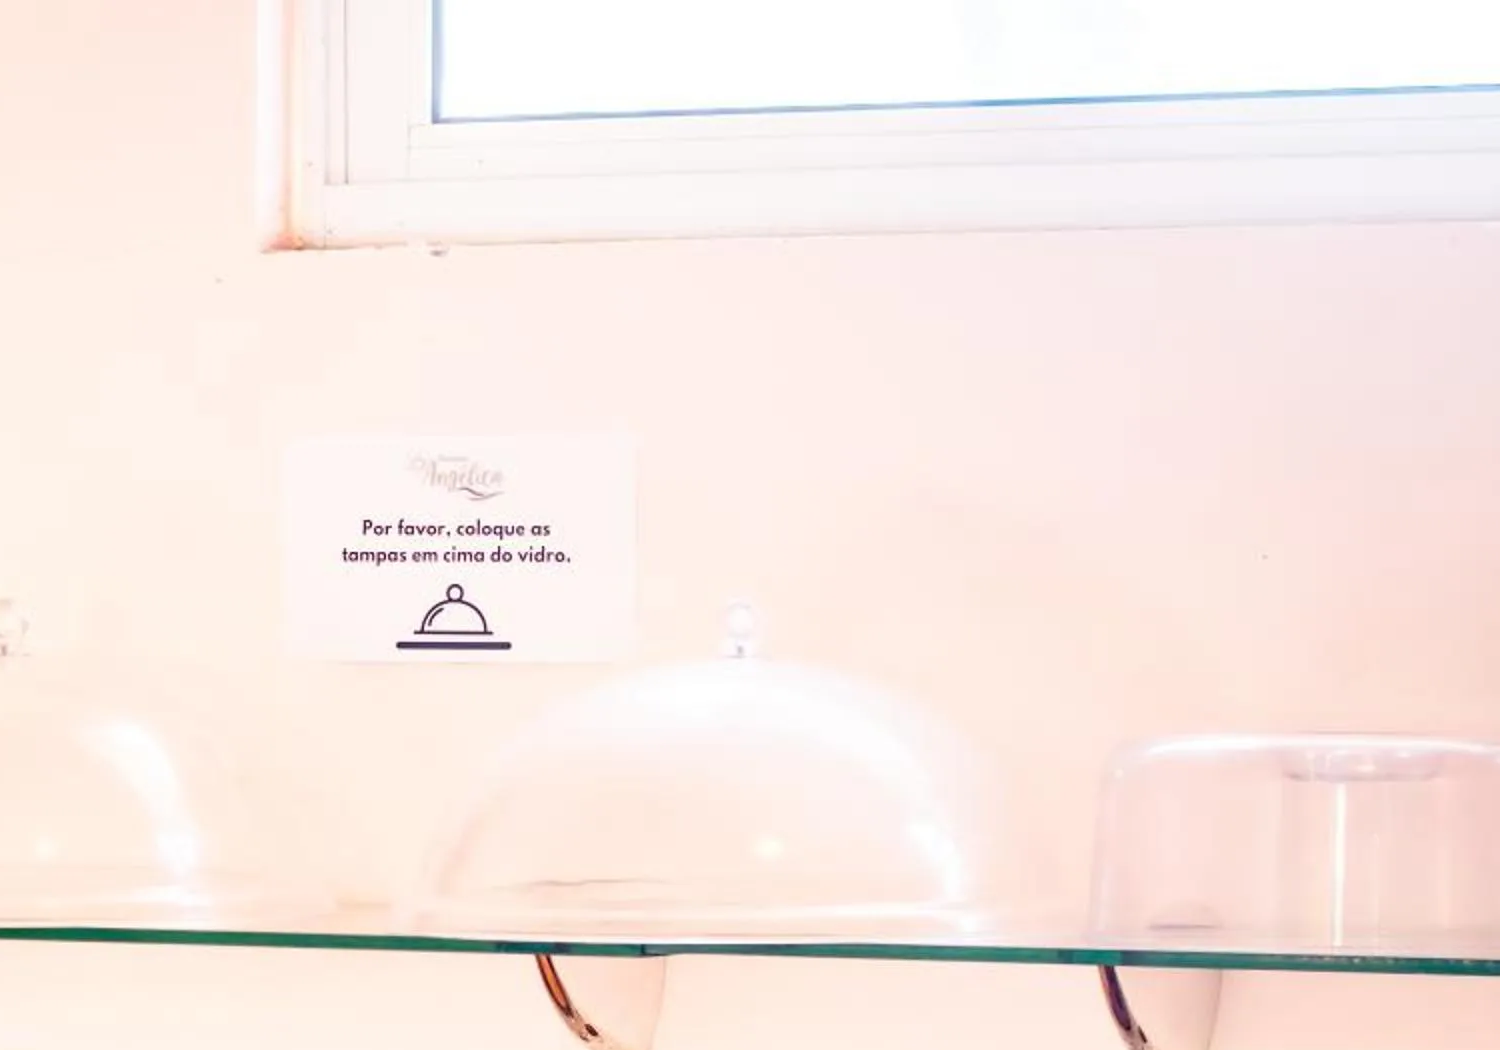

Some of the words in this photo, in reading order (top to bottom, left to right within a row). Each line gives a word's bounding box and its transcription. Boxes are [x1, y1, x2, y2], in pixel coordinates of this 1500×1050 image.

[362, 518, 392, 536] Por
[398, 518, 451, 537] favor,
[456, 518, 526, 540] coloque
[531, 523, 551, 536] as
[342, 547, 407, 566] tampas
[411, 551, 439, 563] em
[443, 546, 485, 563] cima
[490, 546, 513, 563] do
[517, 546, 571, 563] vidro.
